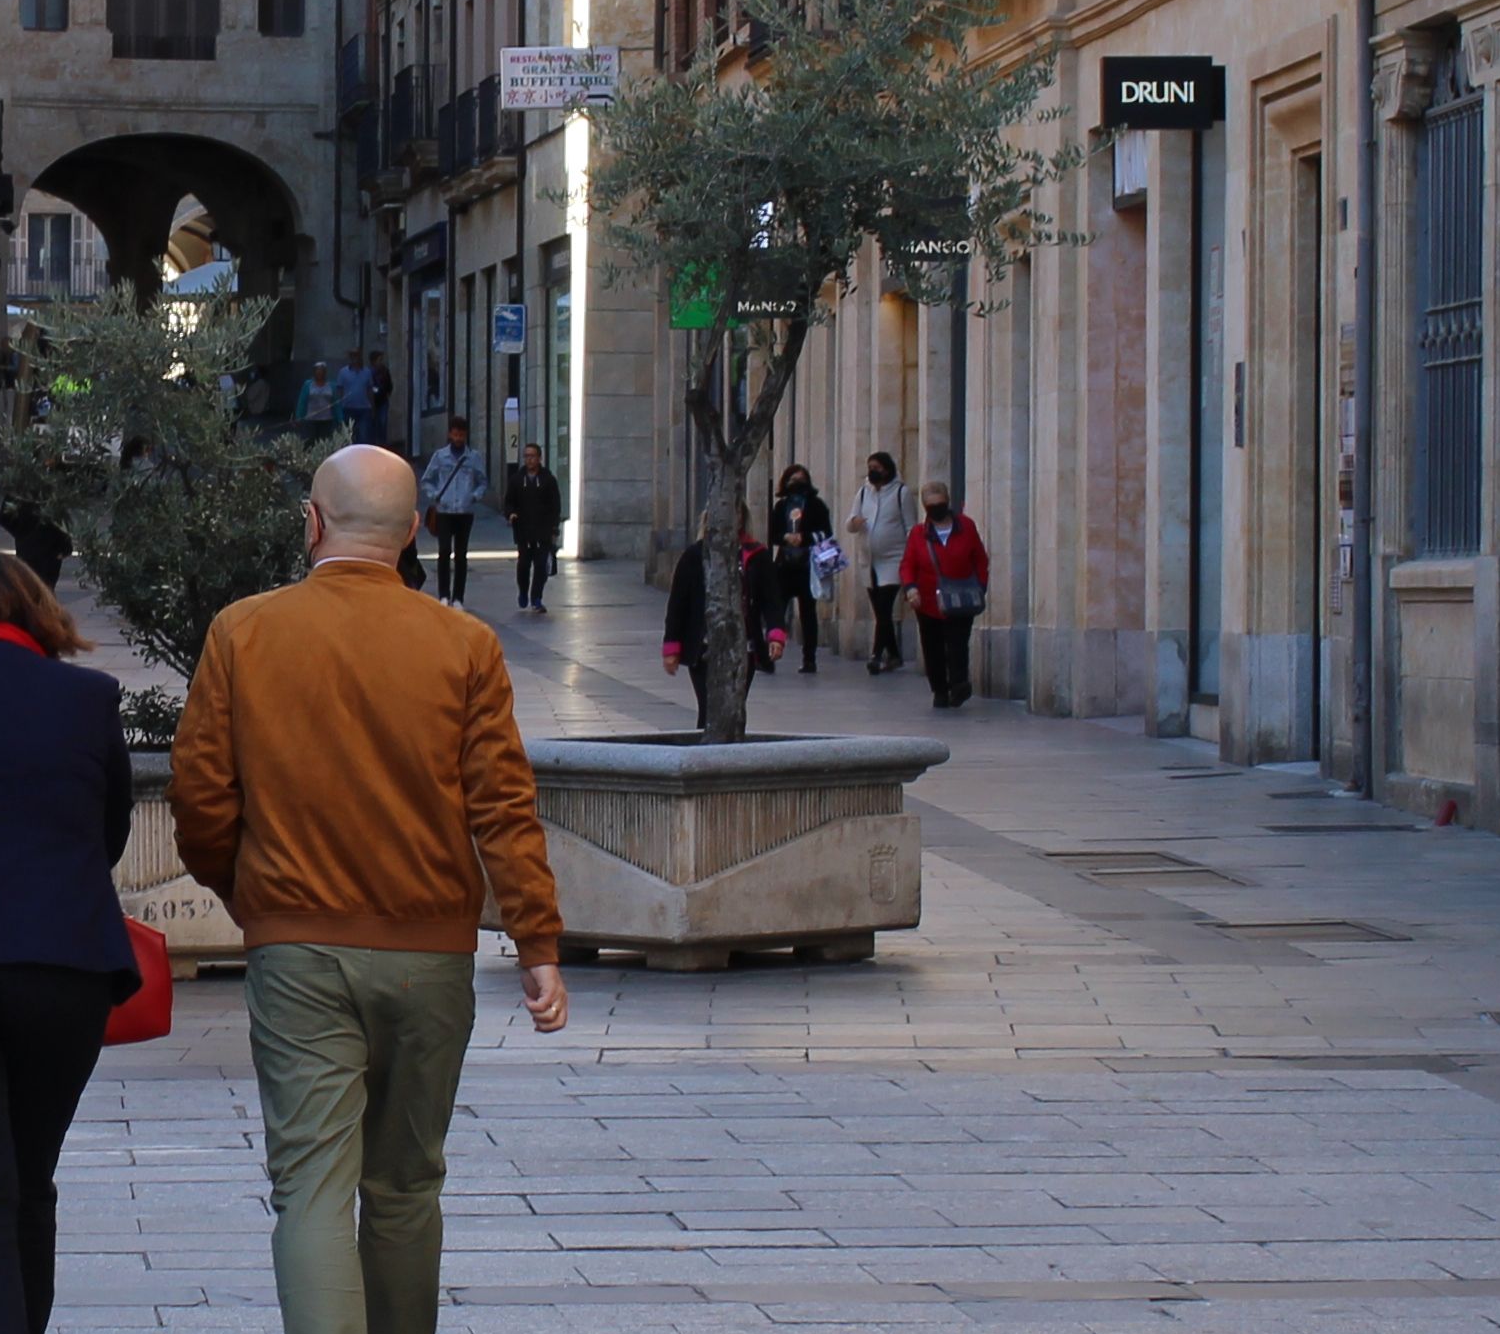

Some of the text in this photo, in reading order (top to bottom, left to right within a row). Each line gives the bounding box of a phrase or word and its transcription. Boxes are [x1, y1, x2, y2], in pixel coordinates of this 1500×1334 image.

[510, 76, 613, 87] BUFFET LIBRE
[1122, 81, 1195, 104] DRUNI
[510, 434, 518, 448] 2
